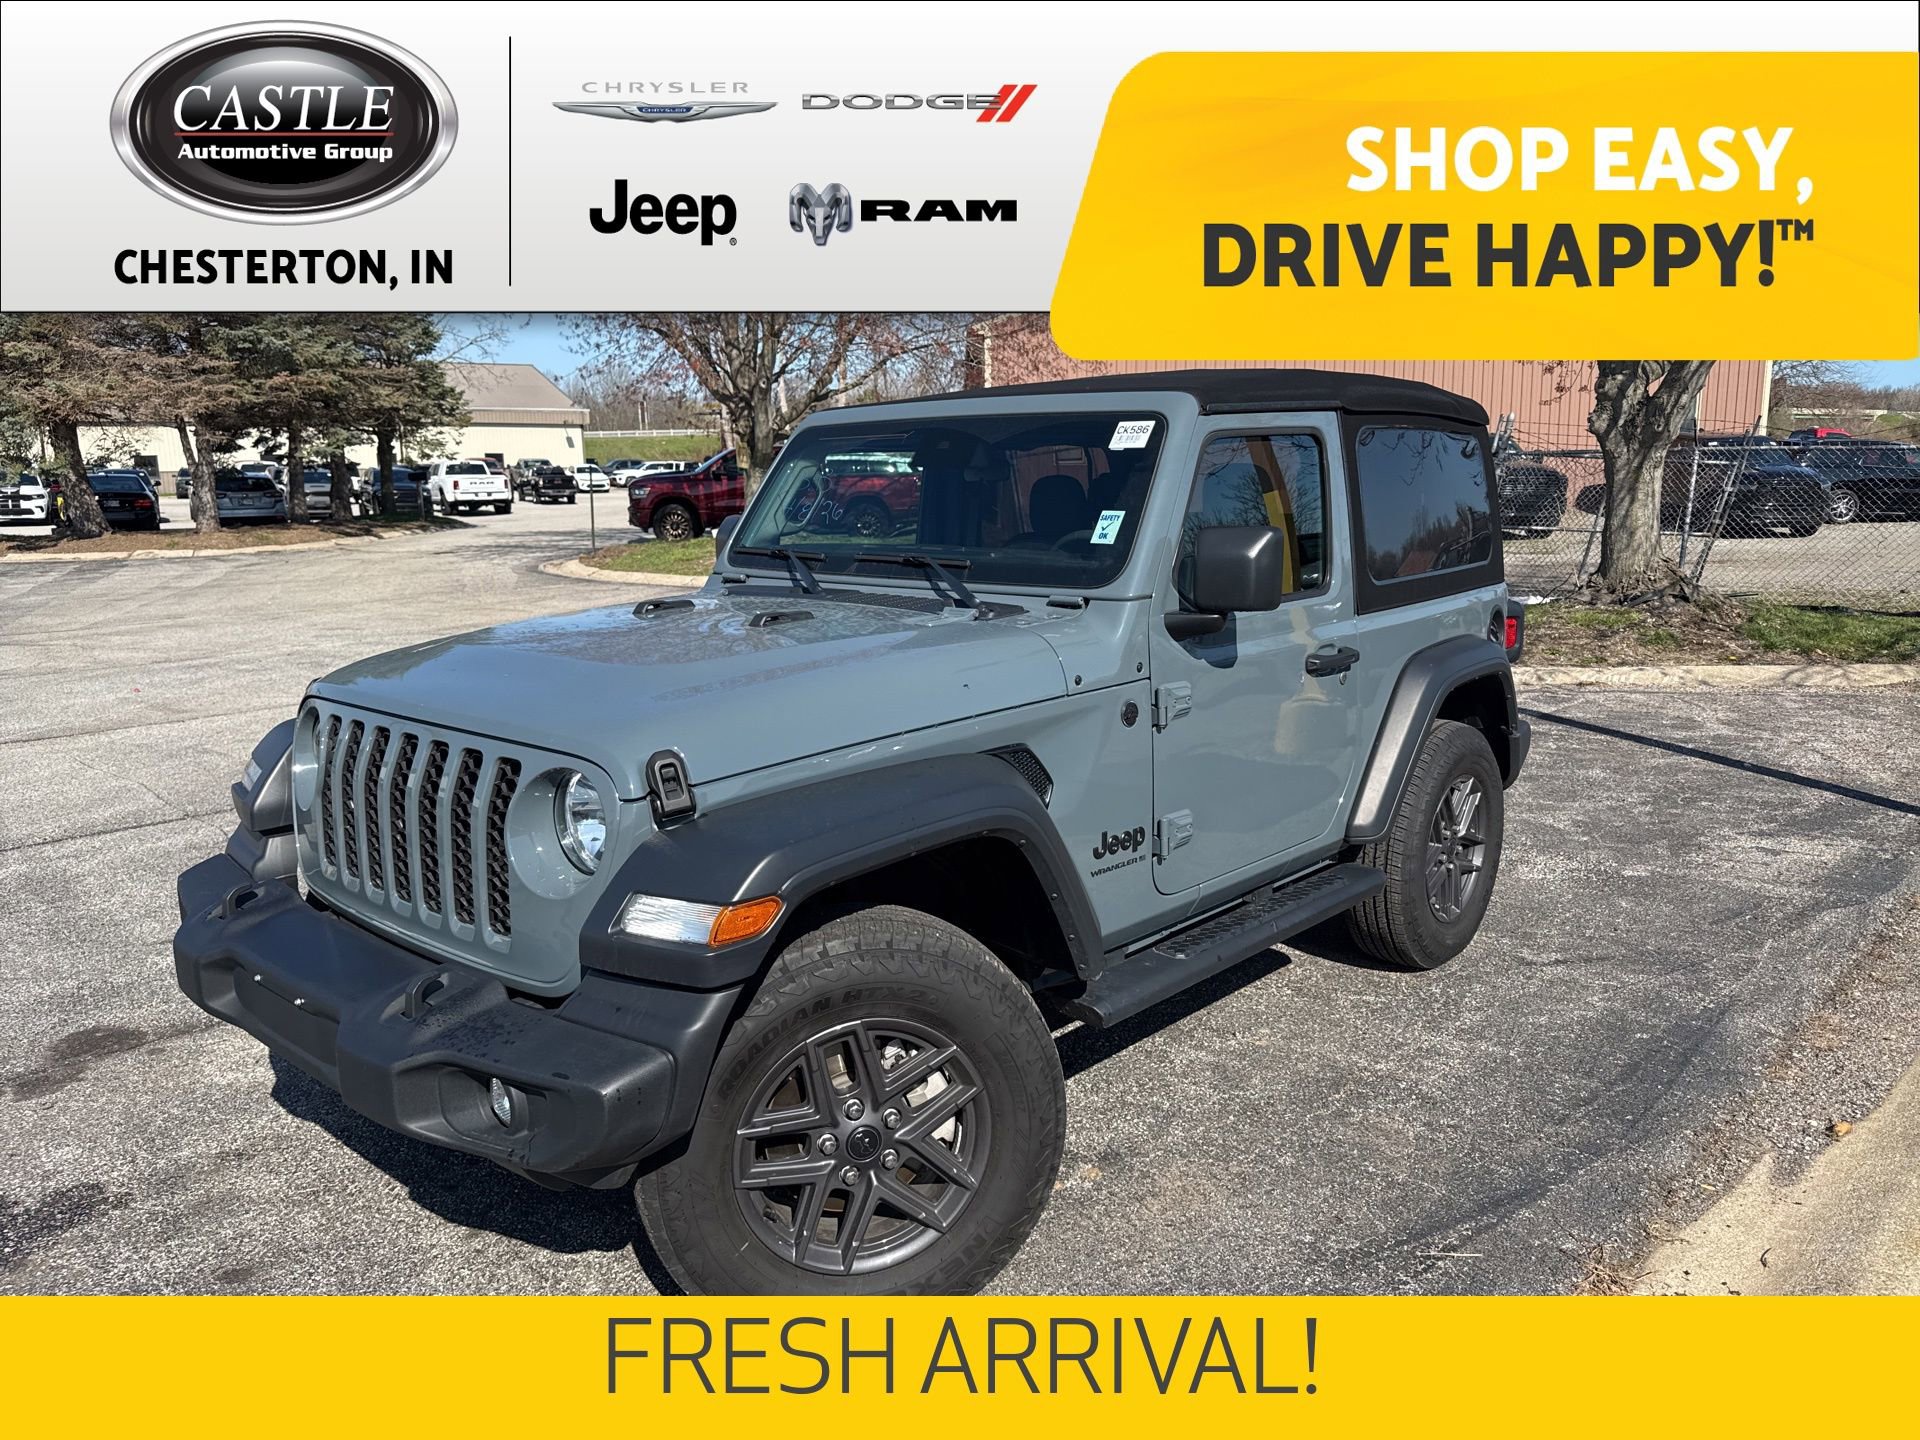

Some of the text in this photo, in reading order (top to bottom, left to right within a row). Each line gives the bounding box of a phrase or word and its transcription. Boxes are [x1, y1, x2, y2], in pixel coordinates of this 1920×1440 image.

[1116, 425, 1150, 435] CK586
[1098, 532, 1109, 540] OK
[1092, 826, 1146, 860] Jeep
[1090, 857, 1138, 878] WRANGLER
[717, 995, 832, 1100] ROADIAN
